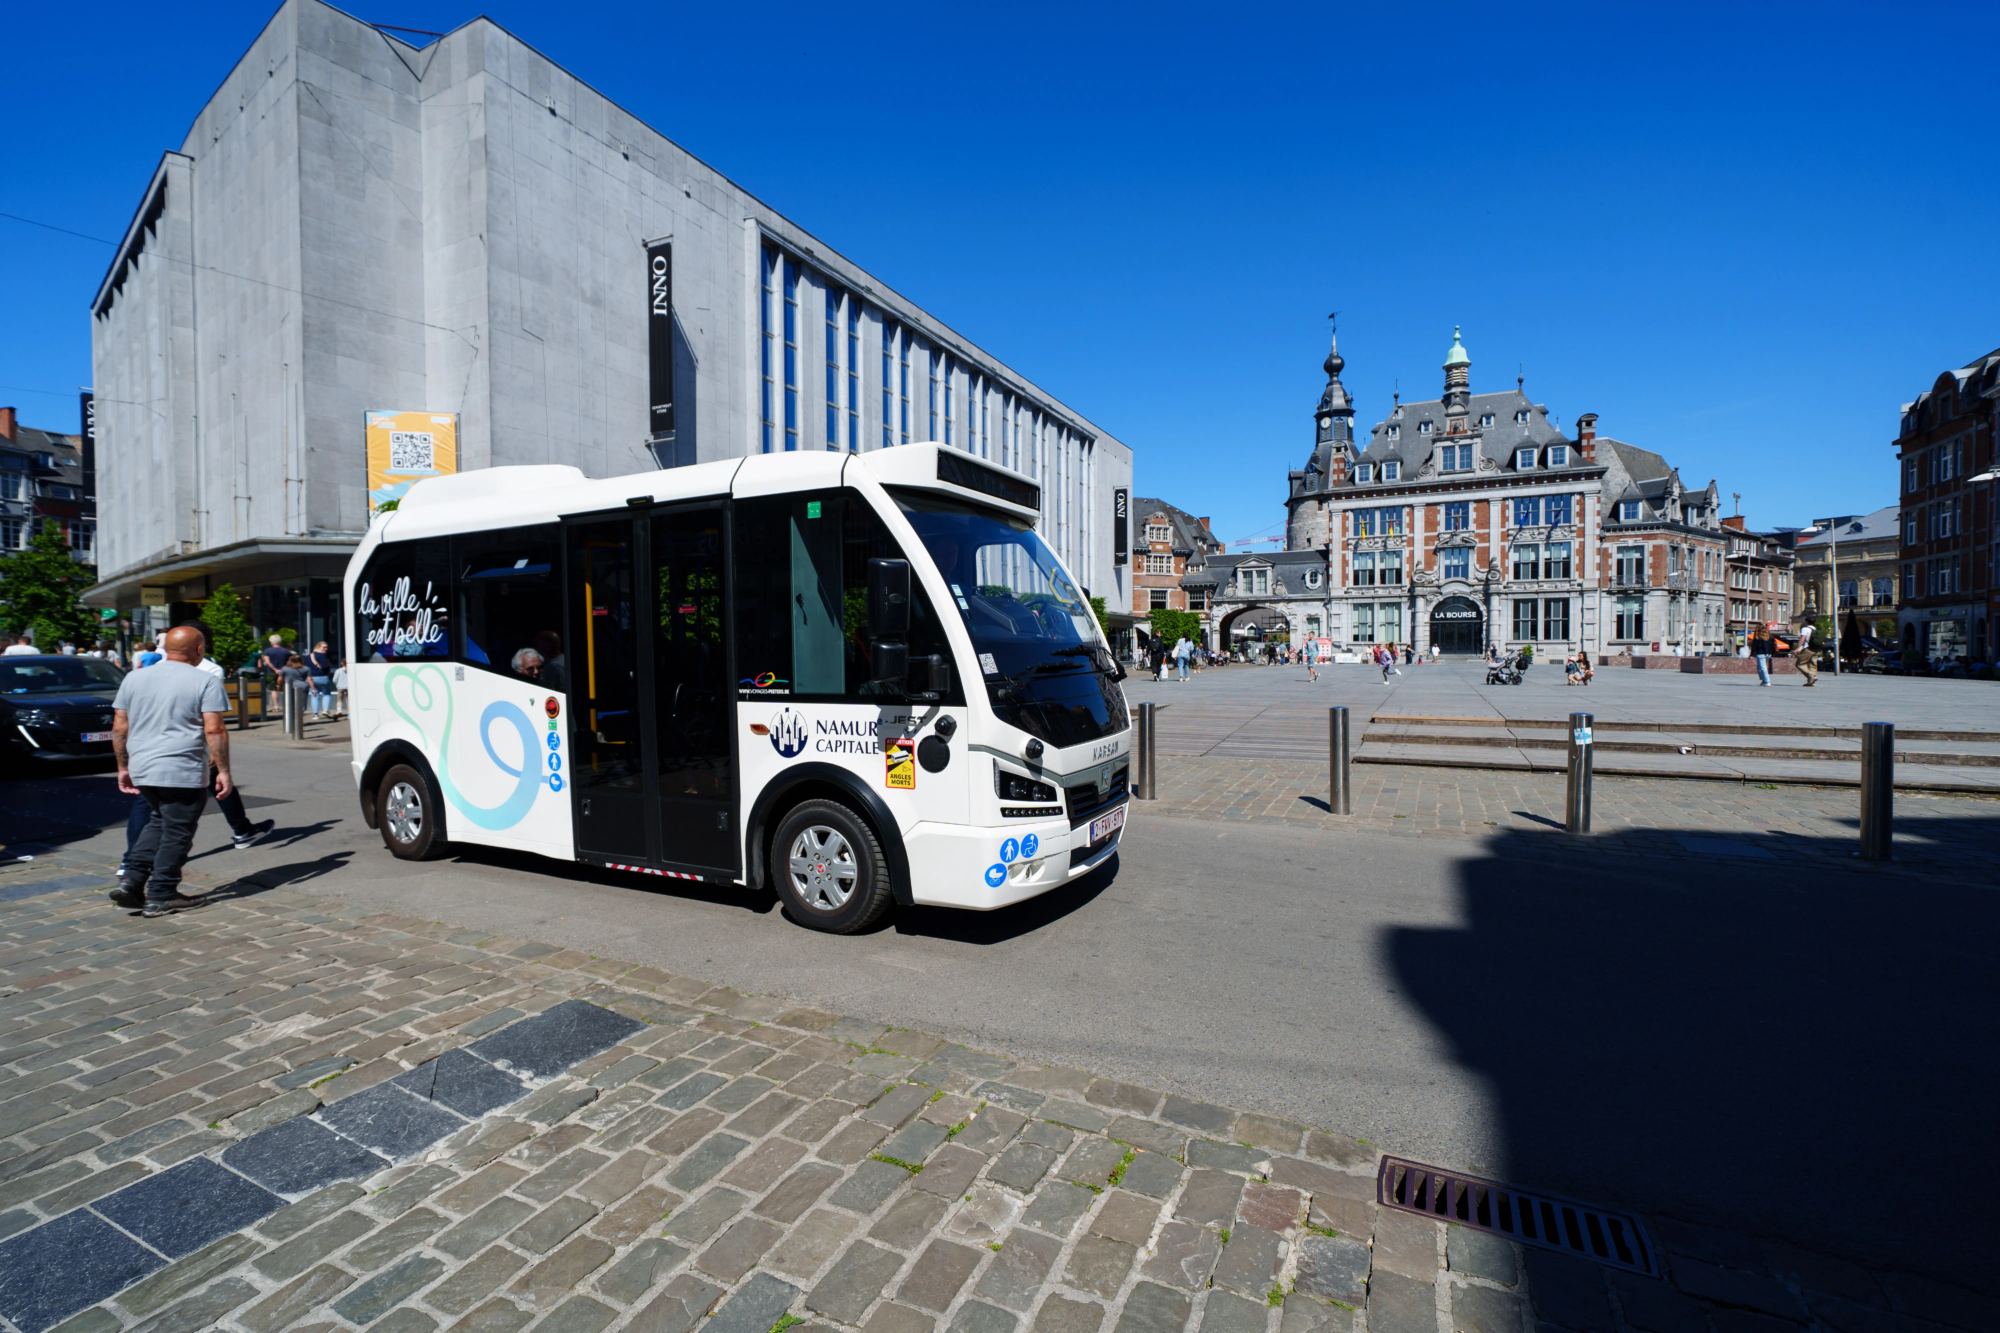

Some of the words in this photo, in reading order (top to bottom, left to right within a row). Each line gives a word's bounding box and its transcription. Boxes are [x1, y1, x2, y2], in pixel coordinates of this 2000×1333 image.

[652, 255, 667, 316] INNO
[1117, 493, 1125, 518] INNO
[358, 582, 380, 615] la
[380, 575, 420, 615] ville
[366, 611, 394, 645] est
[394, 607, 443, 645] belle
[816, 719, 878, 737] NAMUR
[816, 738, 880, 755] CAPITALE
[1093, 740, 1119, 762] KARSAN
